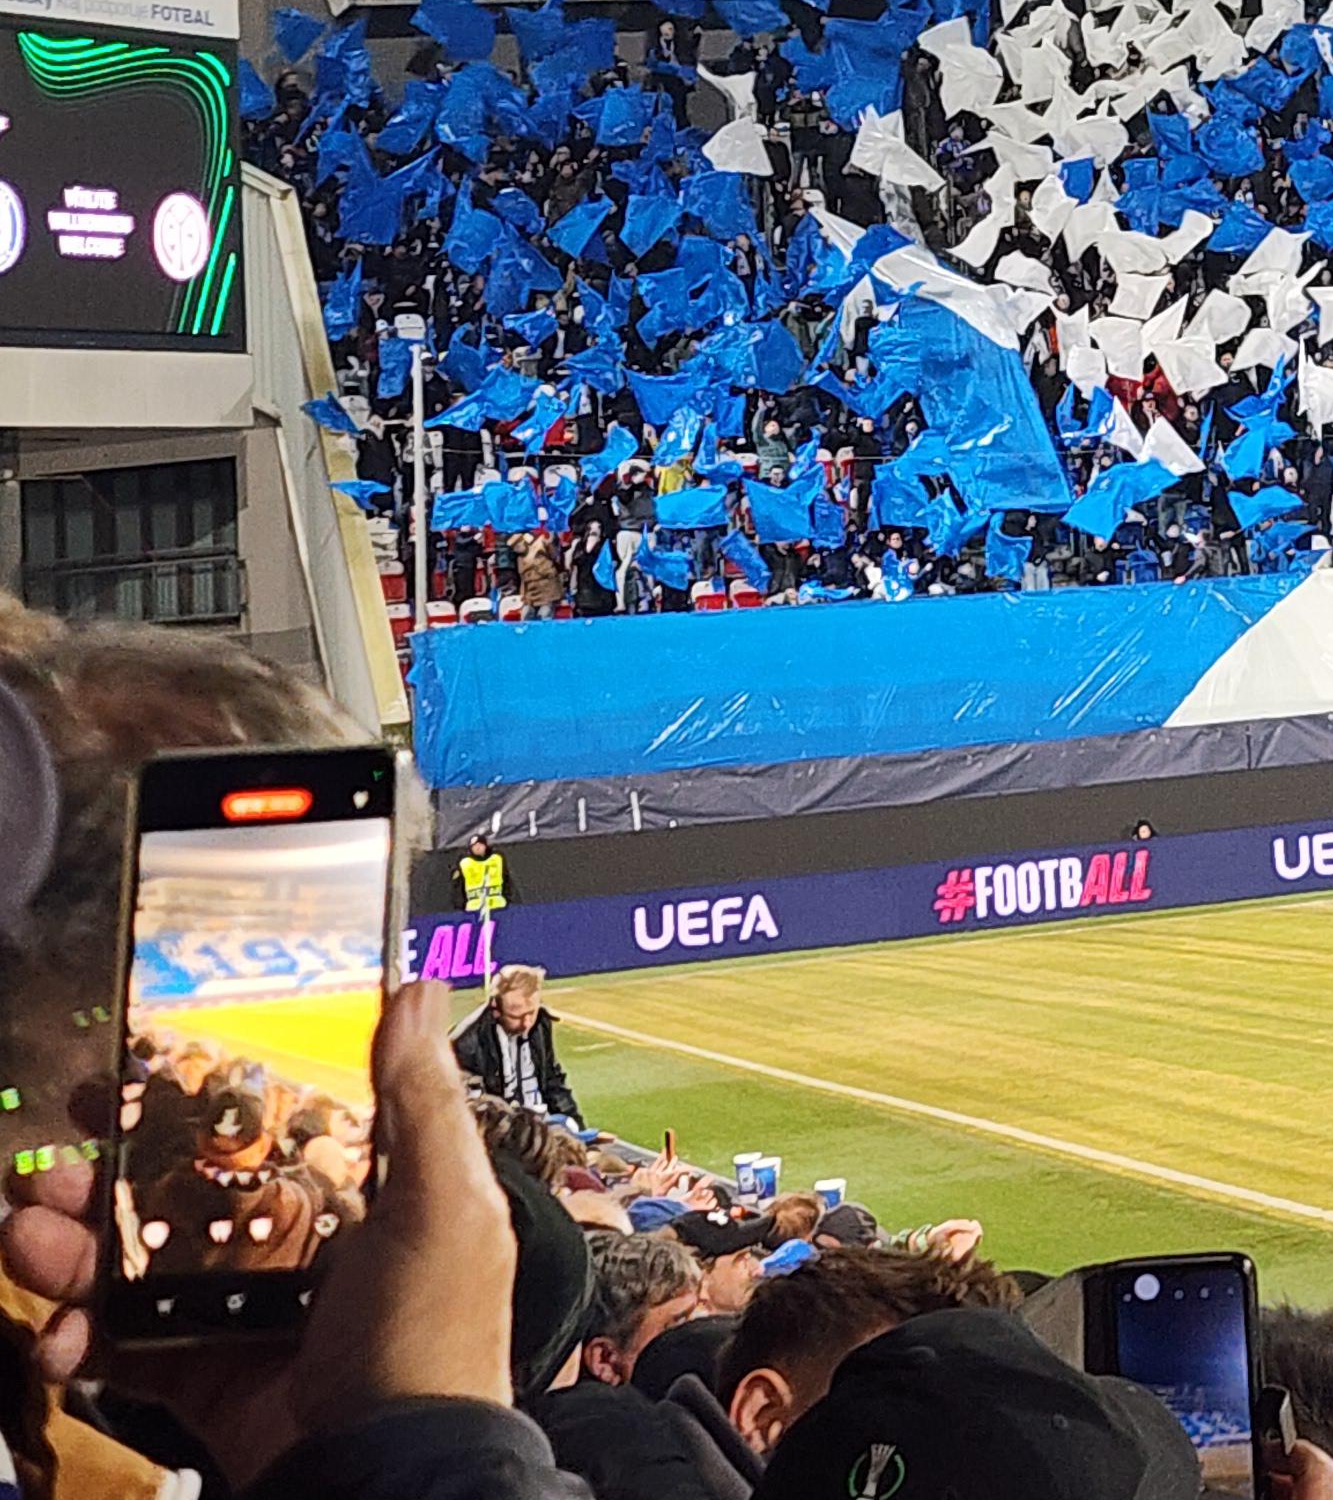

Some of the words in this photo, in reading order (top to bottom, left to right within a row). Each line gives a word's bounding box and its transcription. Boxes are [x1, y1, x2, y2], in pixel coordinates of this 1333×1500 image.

[151, 4, 214, 26] FOTBAL
[934, 850, 1152, 924] #FOOTBALL
[421, 921, 498, 981] ALL
[633, 894, 780, 953] UEFA
